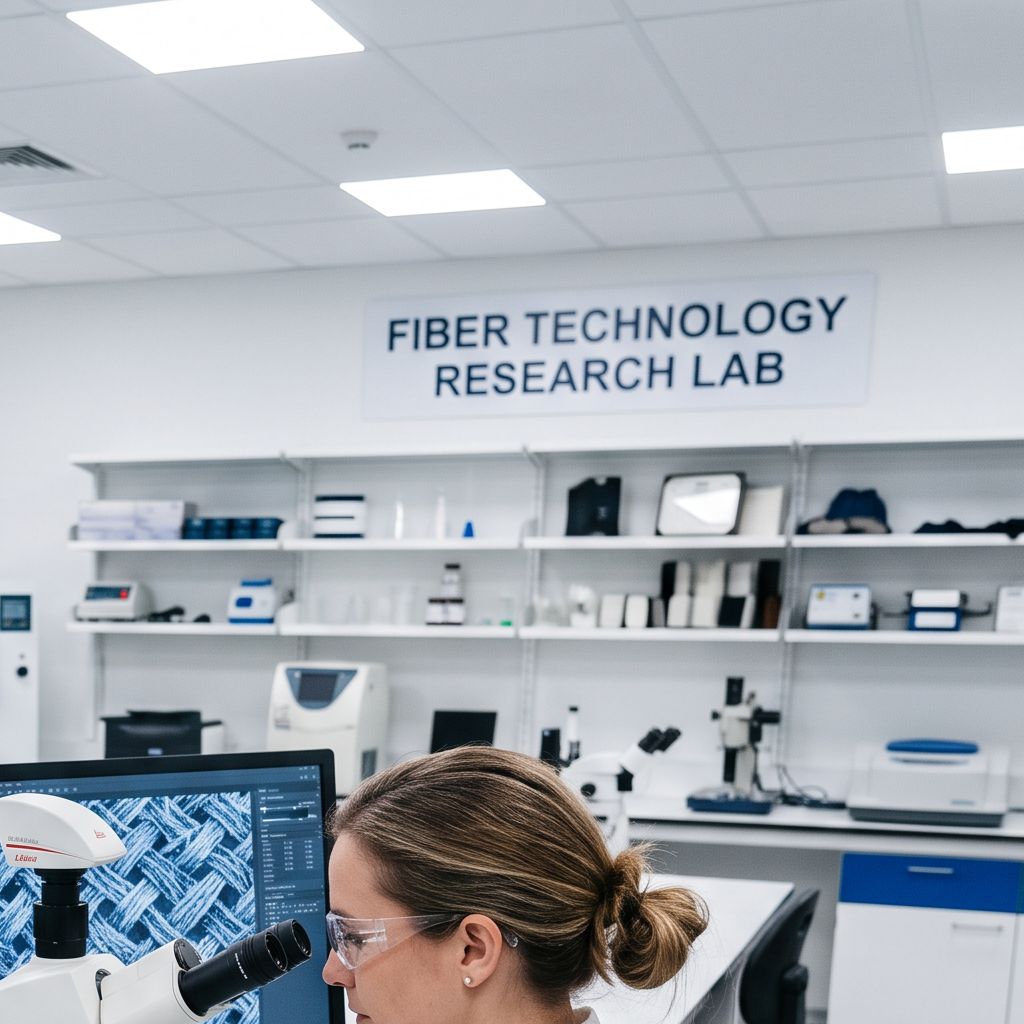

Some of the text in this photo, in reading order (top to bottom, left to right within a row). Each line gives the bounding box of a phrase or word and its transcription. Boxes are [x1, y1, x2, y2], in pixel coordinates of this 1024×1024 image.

[387, 295, 848, 352] FIBER TECHNOLOGY
[434, 350, 785, 397] RESEARCH LAB
